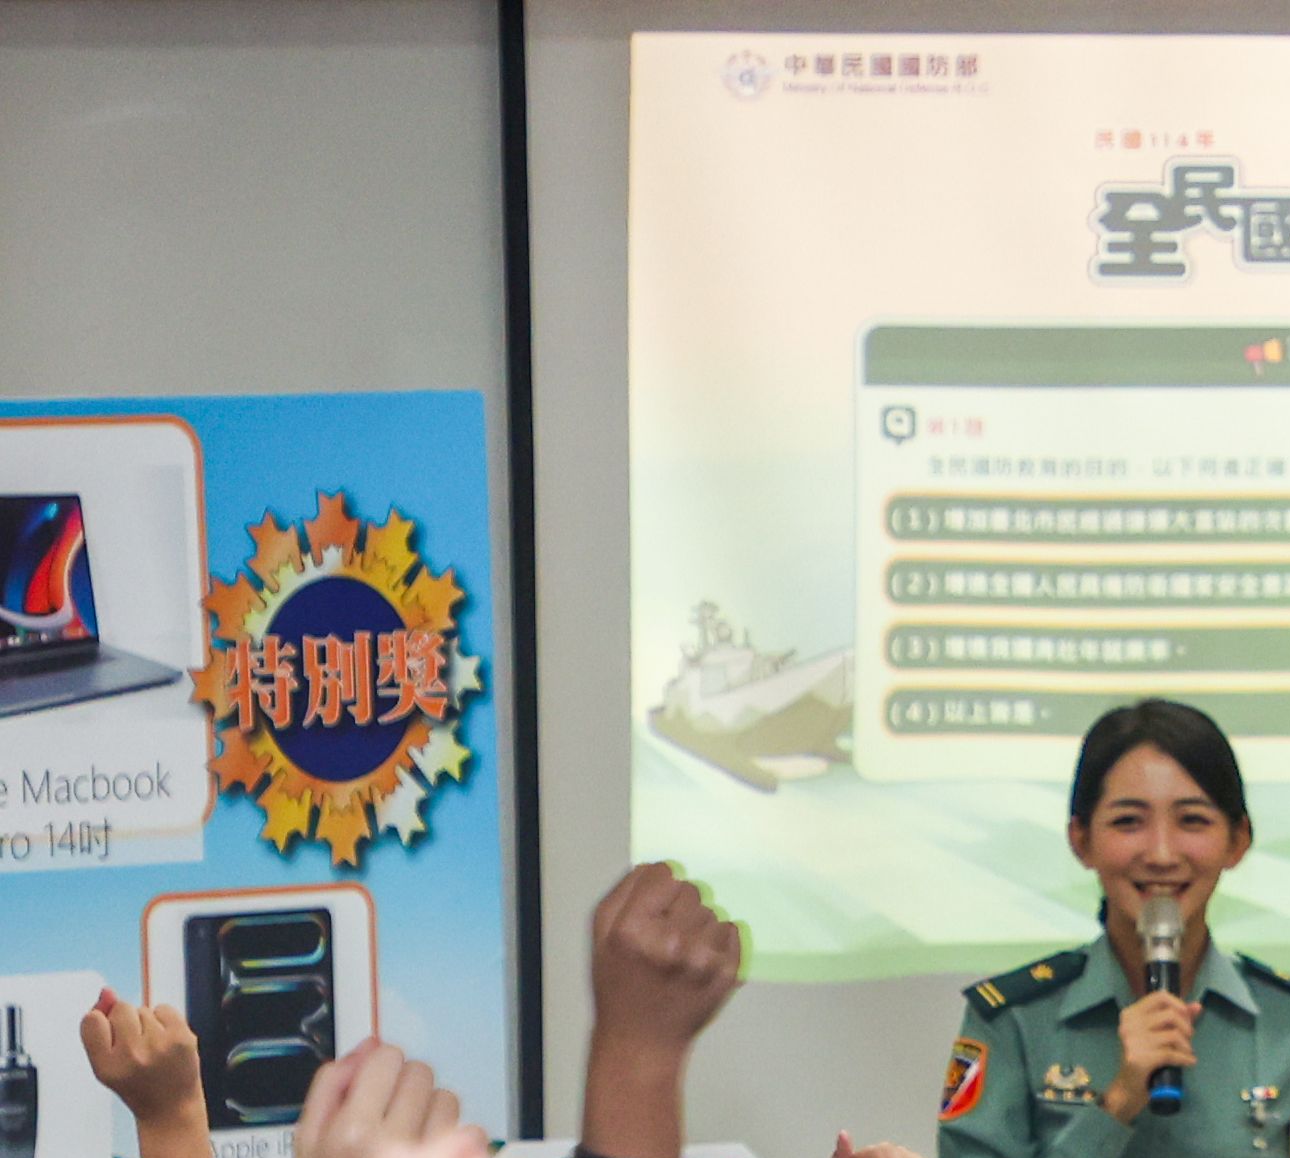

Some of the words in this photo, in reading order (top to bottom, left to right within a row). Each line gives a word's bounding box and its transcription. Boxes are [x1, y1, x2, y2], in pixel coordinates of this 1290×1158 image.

[783, 52, 979, 77] 中華民國國防部
[223, 629, 450, 731] 特別獎
[21, 760, 172, 804] Macbook
[44, 816, 112, 862] 14吋
